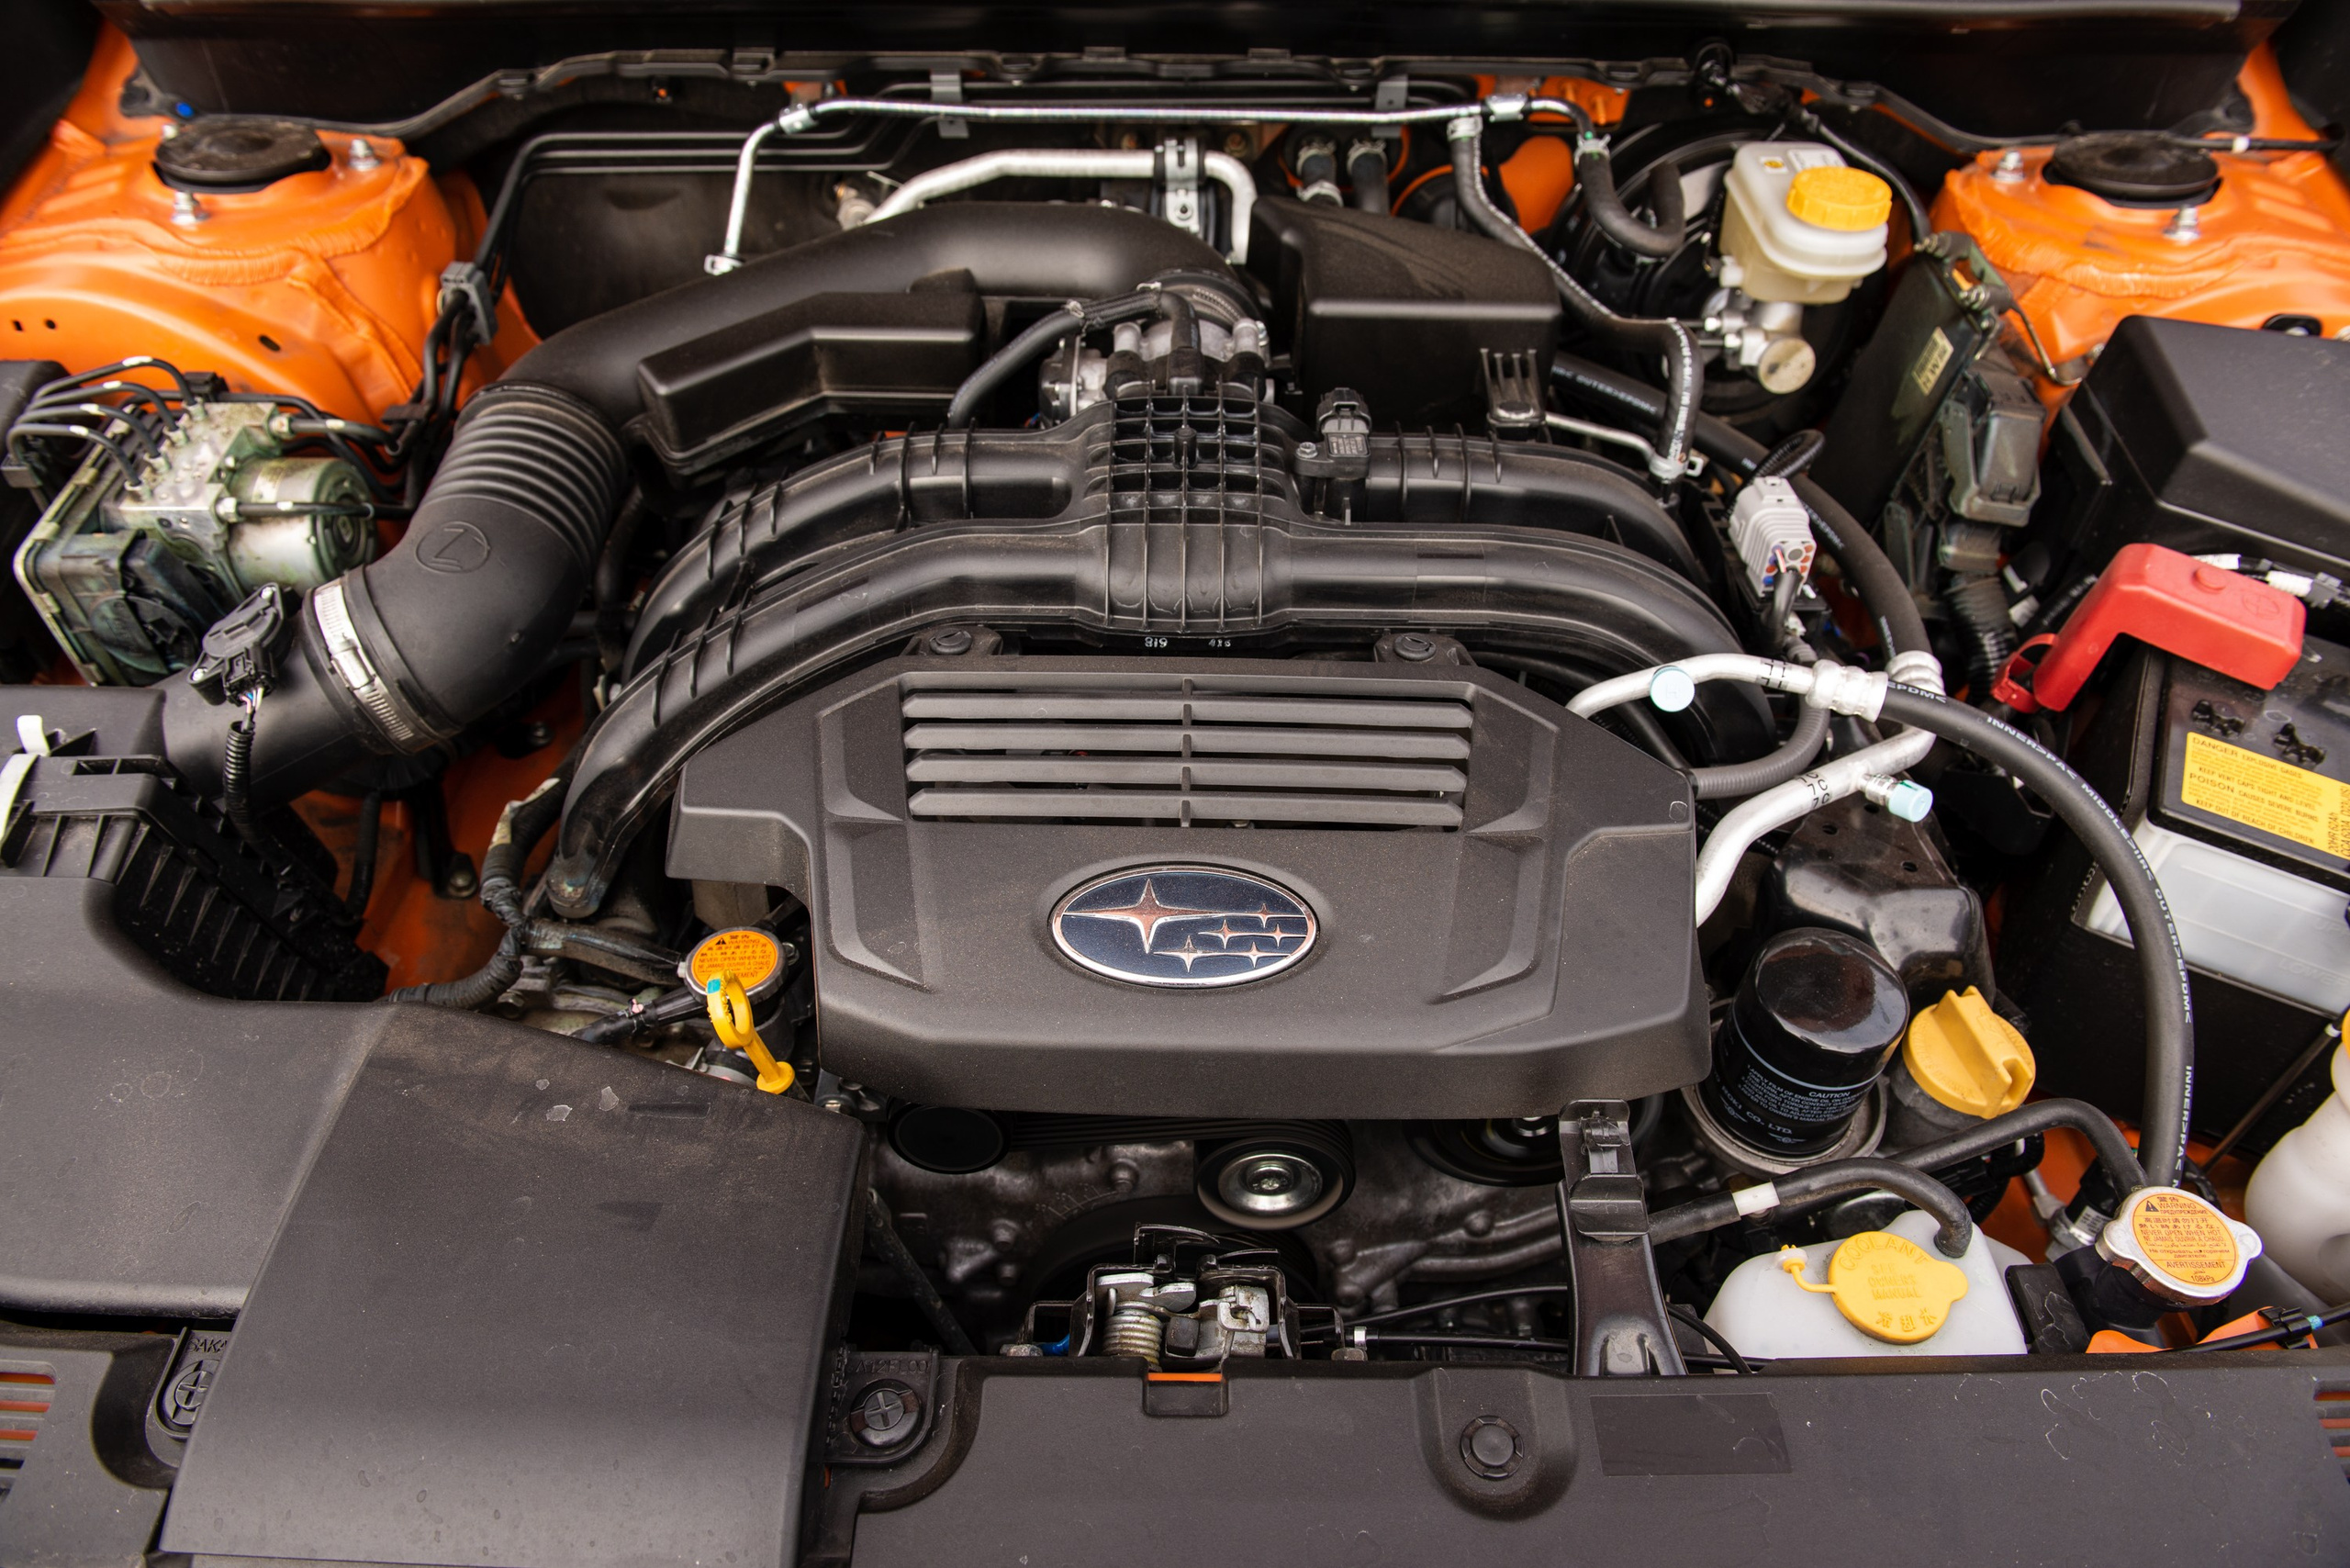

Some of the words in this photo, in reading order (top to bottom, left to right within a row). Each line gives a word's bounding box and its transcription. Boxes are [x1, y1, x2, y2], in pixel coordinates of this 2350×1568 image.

[2193, 736, 2238, 757] DANGER
[2189, 773, 2234, 793] POISON
[1768, 1081, 1784, 1092] FILM
[1721, 1085, 1742, 1110] ROKI
[1839, 1235, 1929, 1271] COOLANT
[1871, 1287, 1922, 1301] MANUAL
